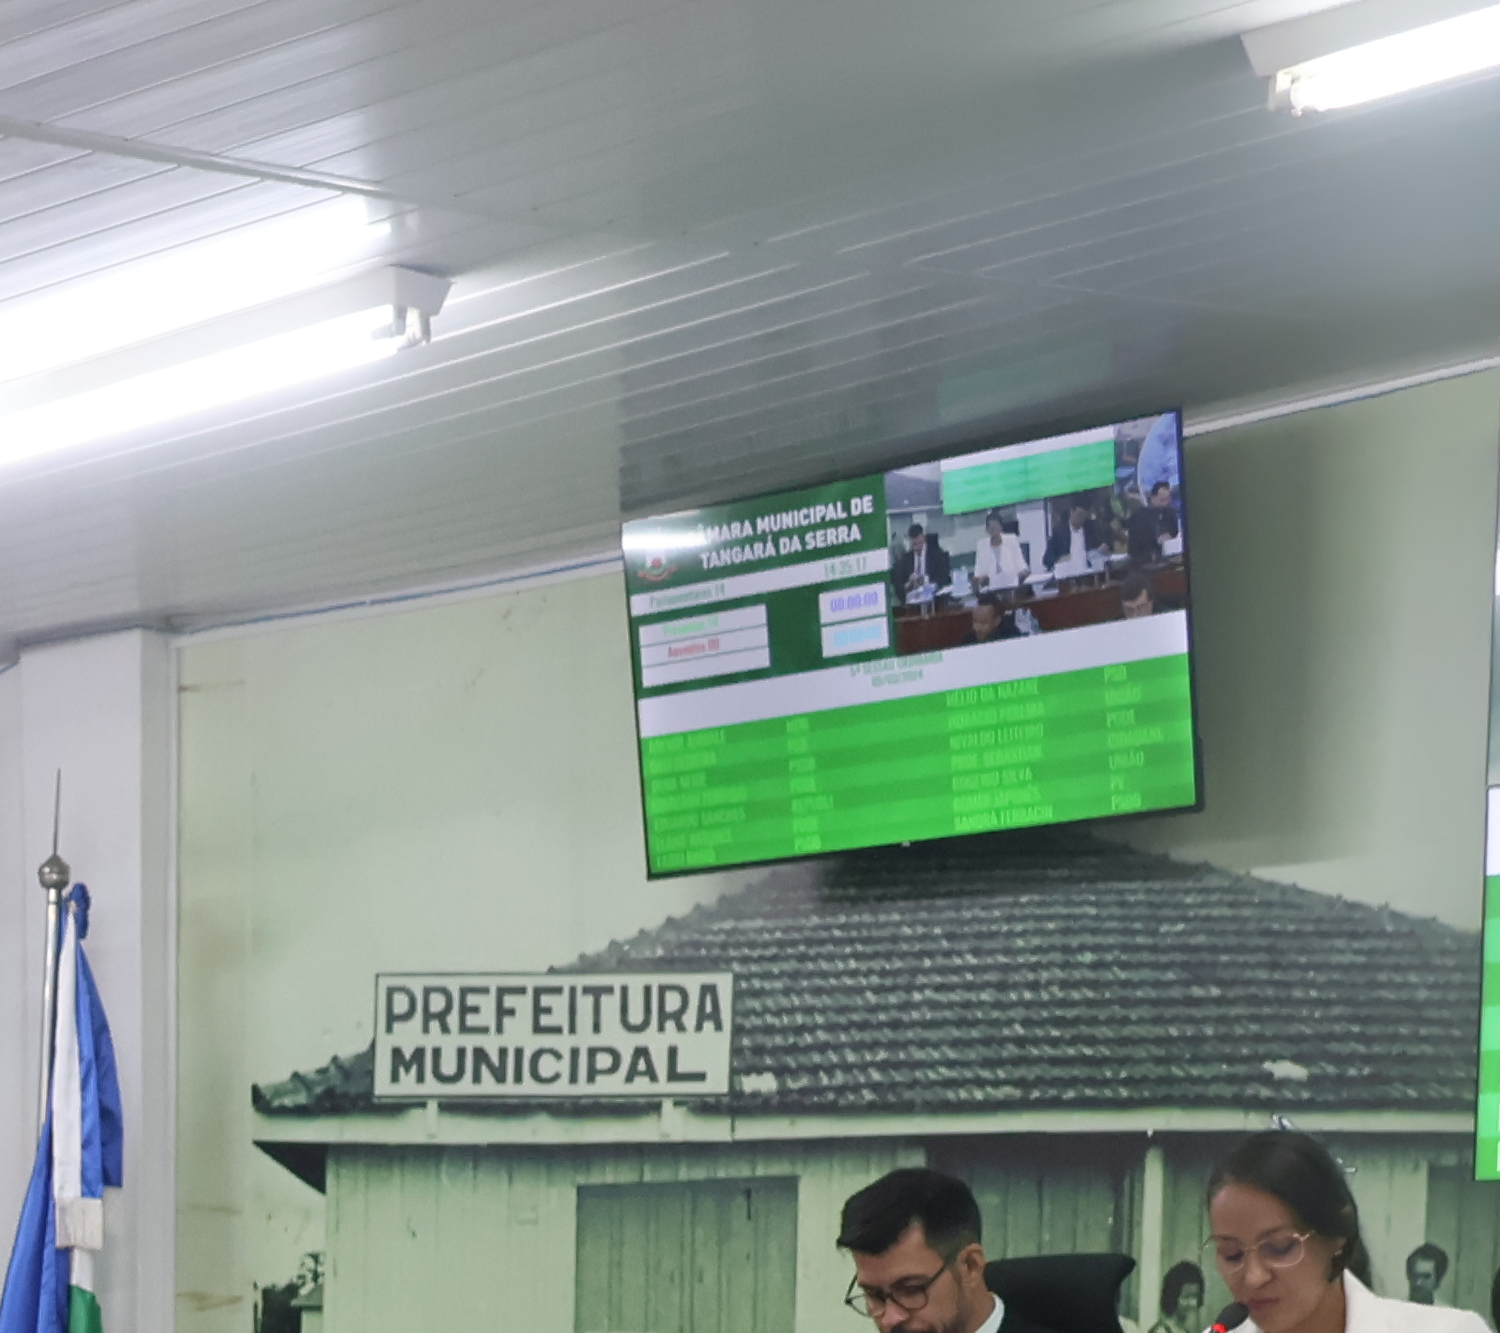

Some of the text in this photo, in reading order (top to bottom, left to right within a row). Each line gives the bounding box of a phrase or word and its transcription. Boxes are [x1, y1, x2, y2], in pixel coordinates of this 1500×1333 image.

[756, 501, 847, 534] MUNICIPAL
[850, 494, 874, 515] DE
[701, 522, 862, 569] TANGARÁ DA SERRA
[384, 983, 724, 1035] PREFEITURA
[389, 1045, 708, 1085] MUNICIPAL
